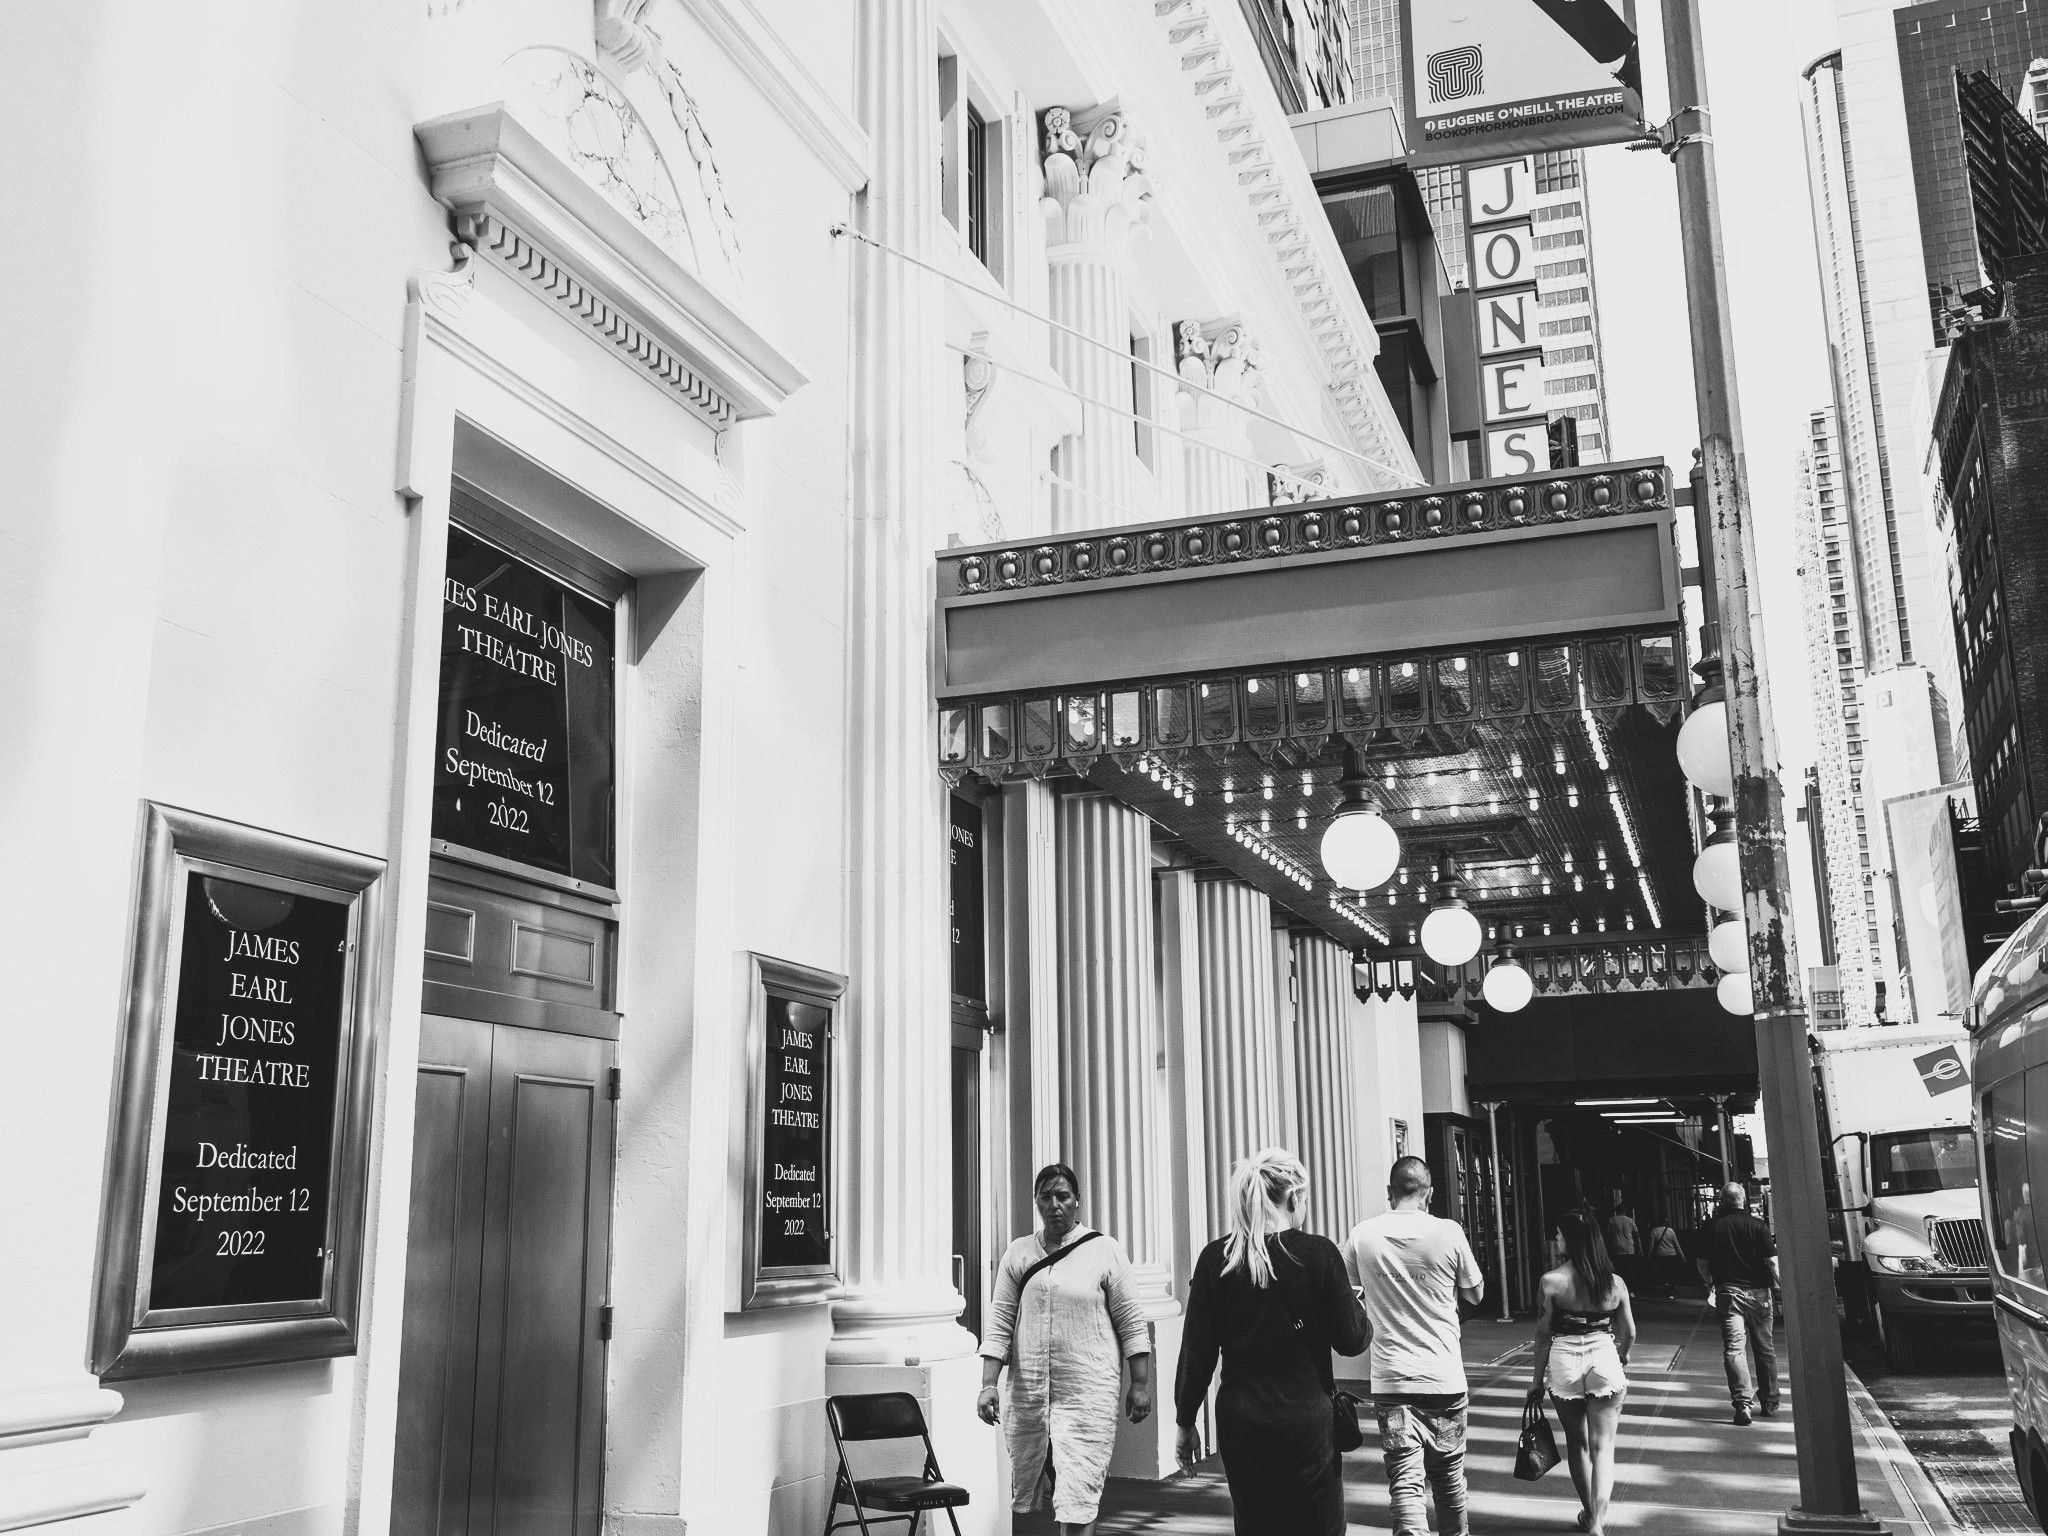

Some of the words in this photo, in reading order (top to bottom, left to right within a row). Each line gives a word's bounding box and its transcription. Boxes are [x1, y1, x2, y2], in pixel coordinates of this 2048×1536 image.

[1425, 104, 1624, 141] BOOKOFMORMONBROADWAY.COM
[1437, 111, 1495, 130] EUGENE
[1497, 102, 1554, 120] O'NEILL
[1555, 92, 1624, 111] THEATRE
[1481, 166, 1535, 477] JONES
[483, 593, 539, 638] EARL
[540, 620, 593, 668] JONES
[457, 624, 557, 686] THEATRE
[465, 709, 547, 763] Dedicated
[445, 747, 533, 799] September
[536, 780, 554, 806] 12
[487, 800, 530, 834] 2022
[224, 930, 300, 964] JAMES
[952, 927, 960, 944] 12
[230, 973, 293, 1004] EARL
[216, 1014, 295, 1046] JONES
[781, 1028, 813, 1050] JAMES
[196, 1054, 310, 1088] THEATRE
[784, 1056, 811, 1075] EARL
[780, 1082, 813, 1104] JONES
[772, 1108, 820, 1129] THEATRE
[195, 1142, 297, 1170] Dedicated
[774, 1163, 816, 1182] Dedicated
[173, 1186, 283, 1221] September
[289, 1187, 310, 1212] 12
[765, 1190, 811, 1214] September
[812, 1192, 822, 1209] 12
[216, 1231, 265, 1256] 2022
[784, 1219, 805, 1236] 2022
